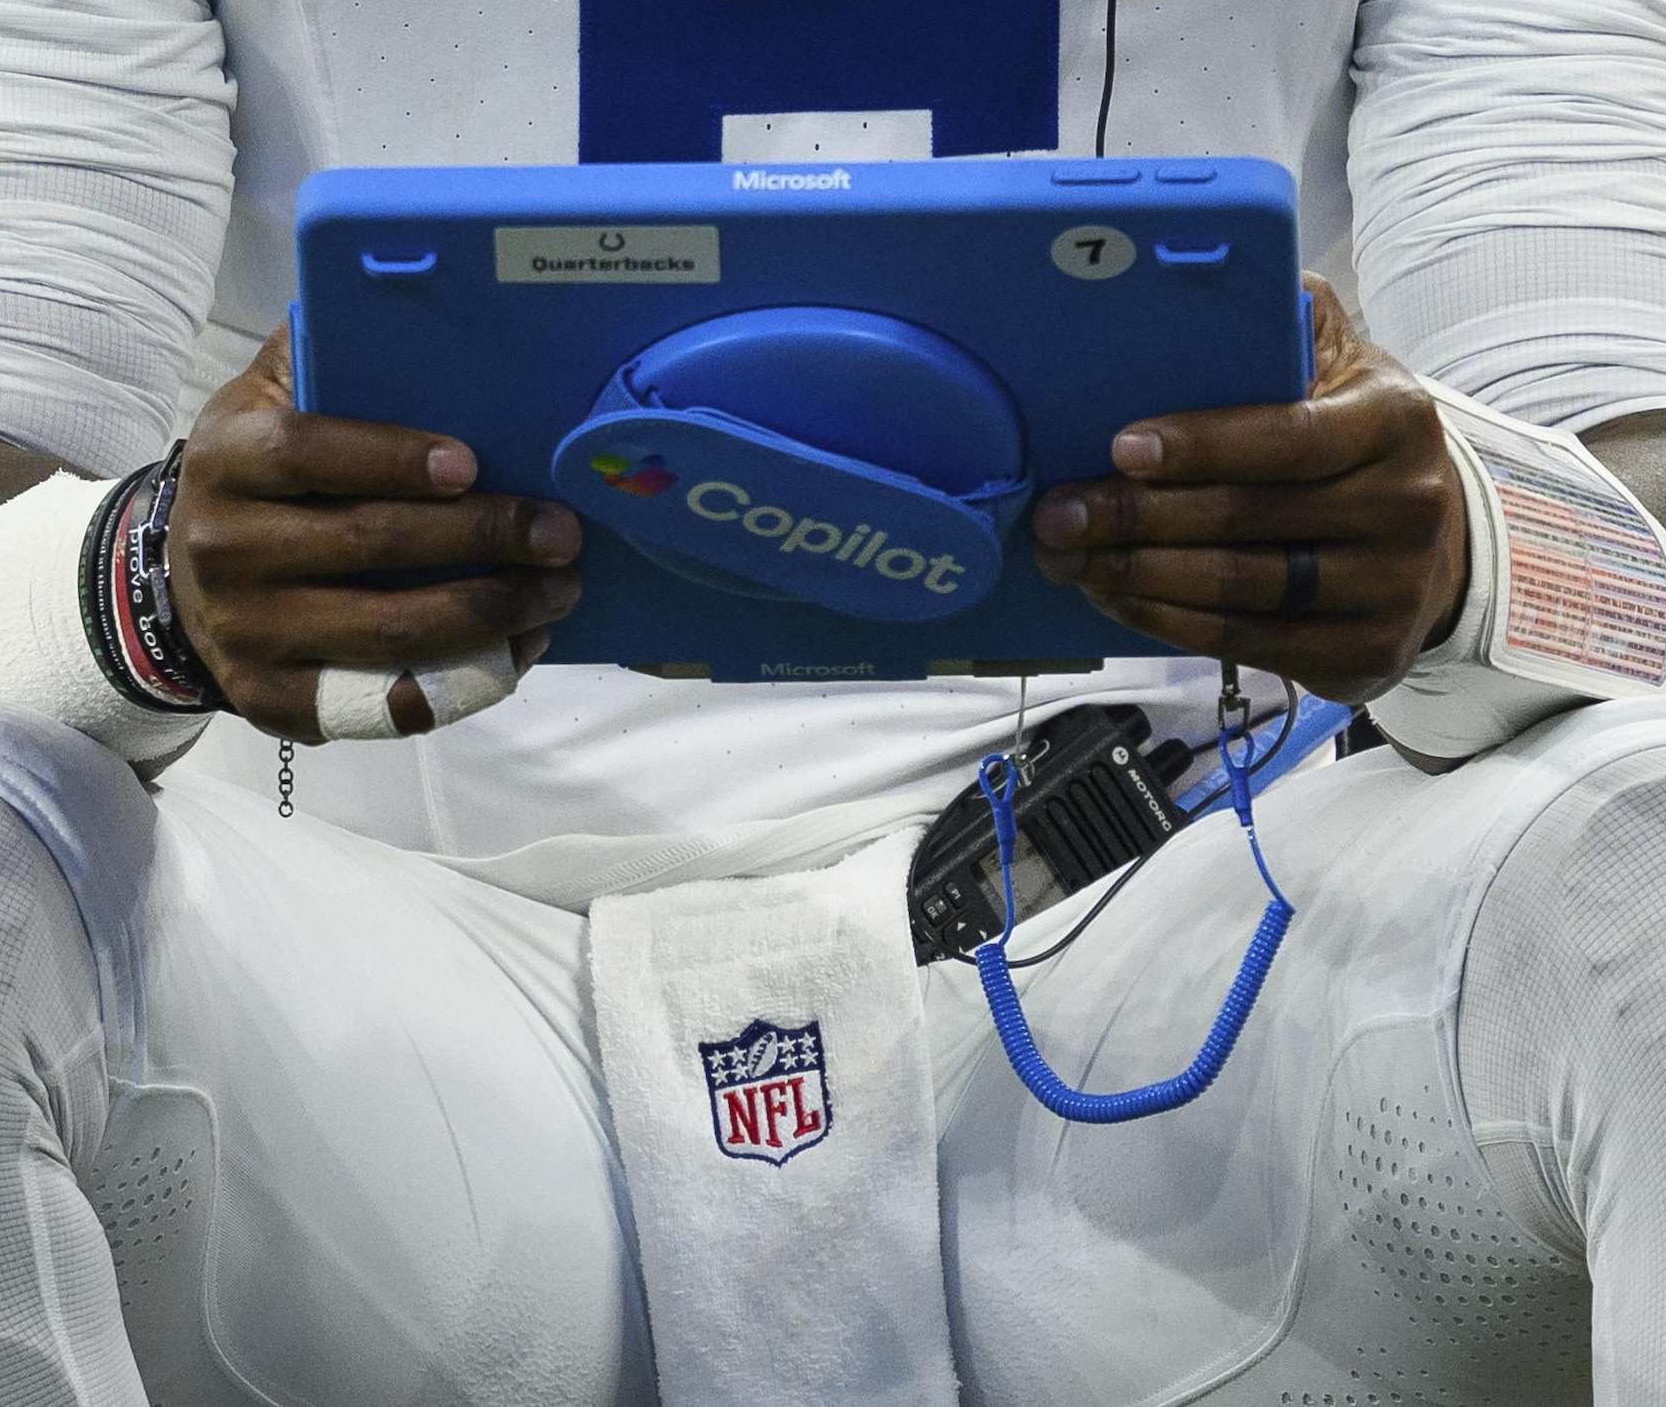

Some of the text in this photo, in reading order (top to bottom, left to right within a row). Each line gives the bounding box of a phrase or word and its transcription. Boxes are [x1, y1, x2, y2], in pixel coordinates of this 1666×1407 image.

[734, 168, 852, 191] Microsoft
[532, 255, 696, 274] Quarterbacks
[1074, 237, 1107, 266] 7
[686, 481, 966, 595] Copilot
[760, 661, 877, 677] Microsoft
[723, 1076, 822, 1148] NFL
